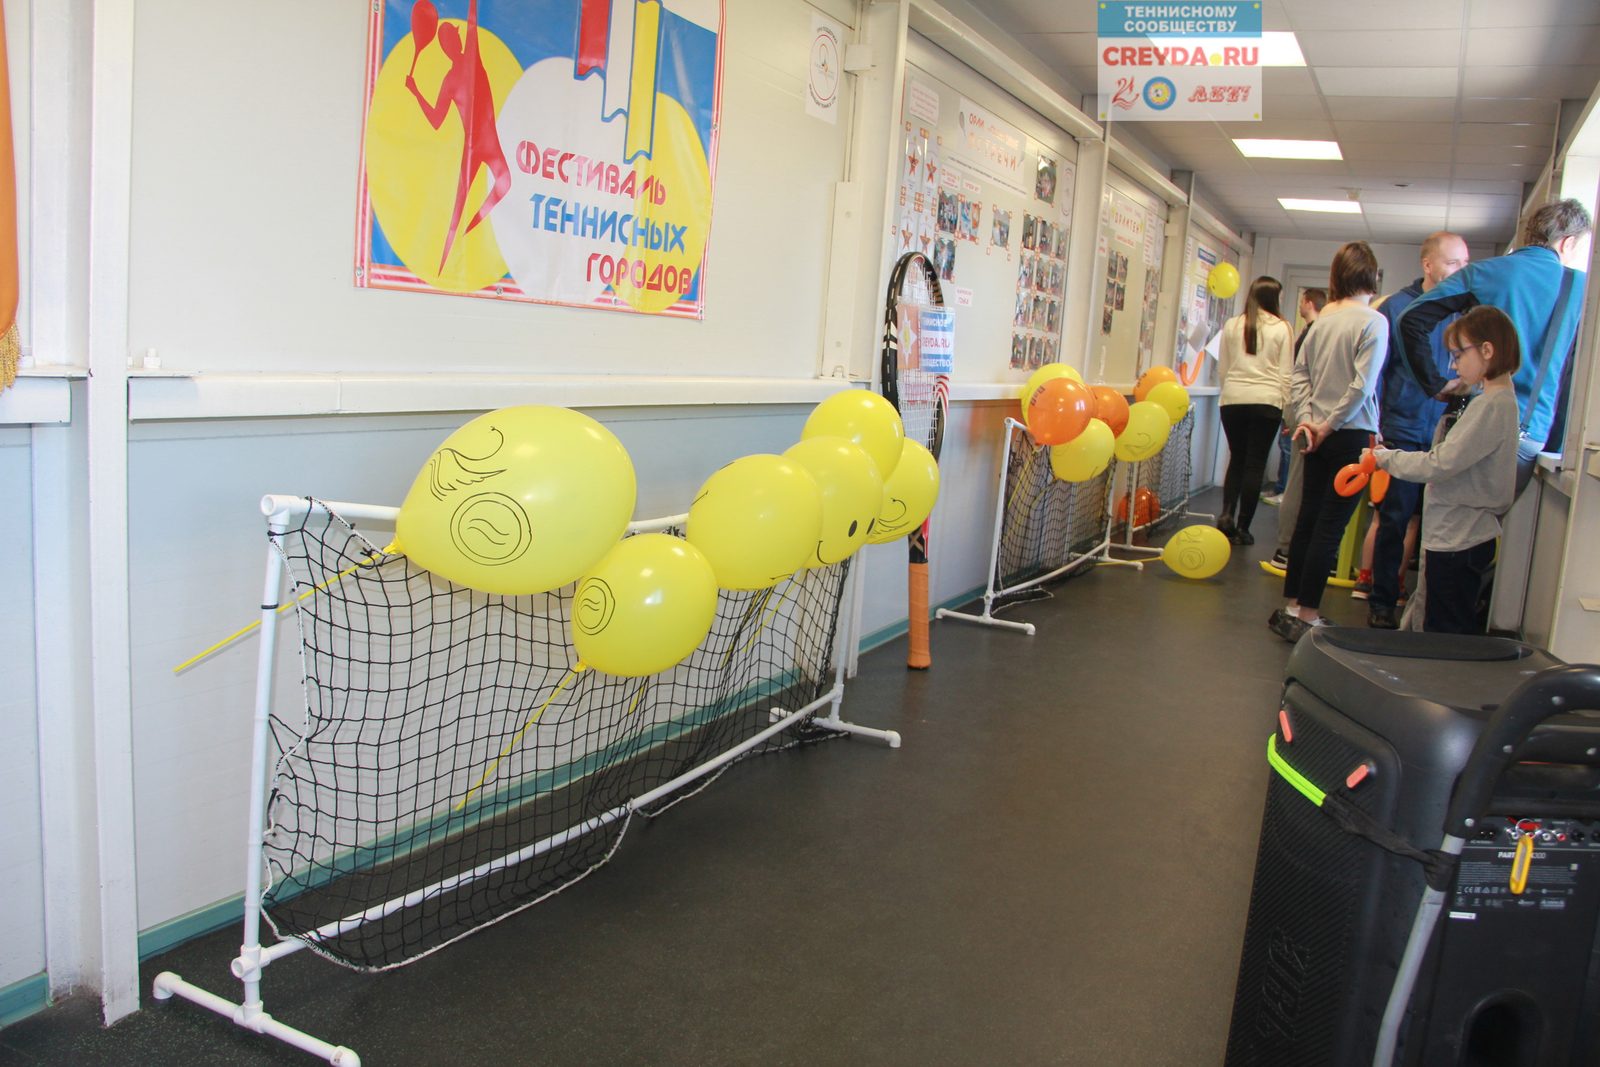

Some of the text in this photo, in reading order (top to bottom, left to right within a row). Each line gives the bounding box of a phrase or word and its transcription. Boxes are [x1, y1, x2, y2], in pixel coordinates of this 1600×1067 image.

[515, 140, 667, 205] ФЕСТИВАЛЬ
[530, 193, 688, 254] ТЕННИСНЫХ
[586, 253, 692, 294] ГОРОДОВ
